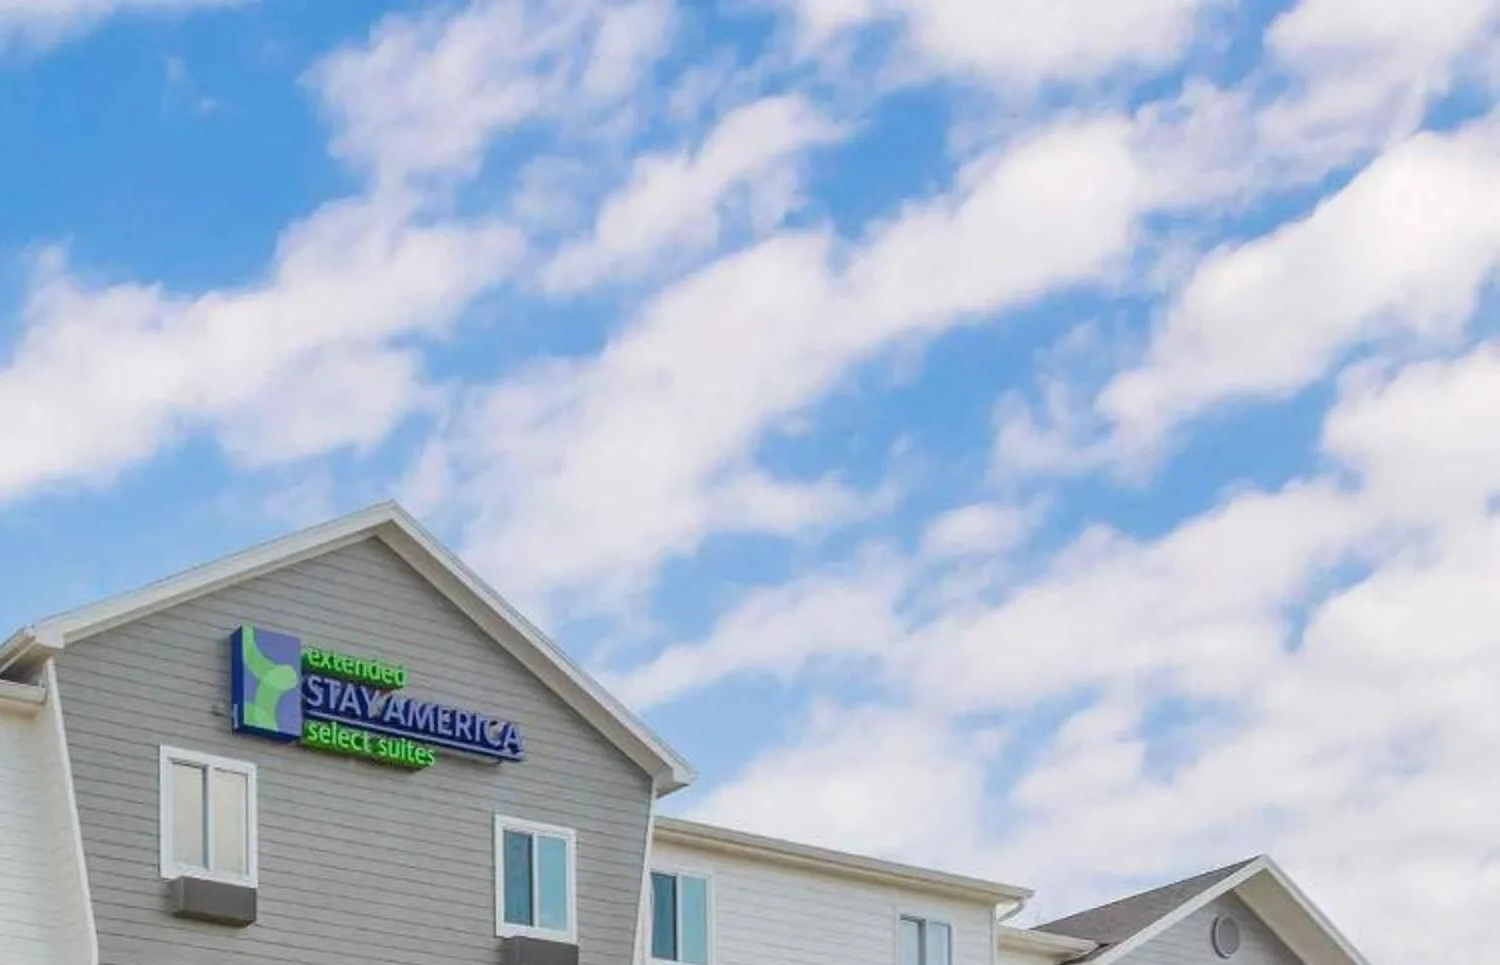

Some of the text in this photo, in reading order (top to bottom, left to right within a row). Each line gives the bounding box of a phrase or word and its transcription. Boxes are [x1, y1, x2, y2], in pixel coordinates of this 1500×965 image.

[306, 648, 406, 687] extended
[305, 675, 522, 750] STAY AMERICA
[307, 721, 435, 767] select suites
